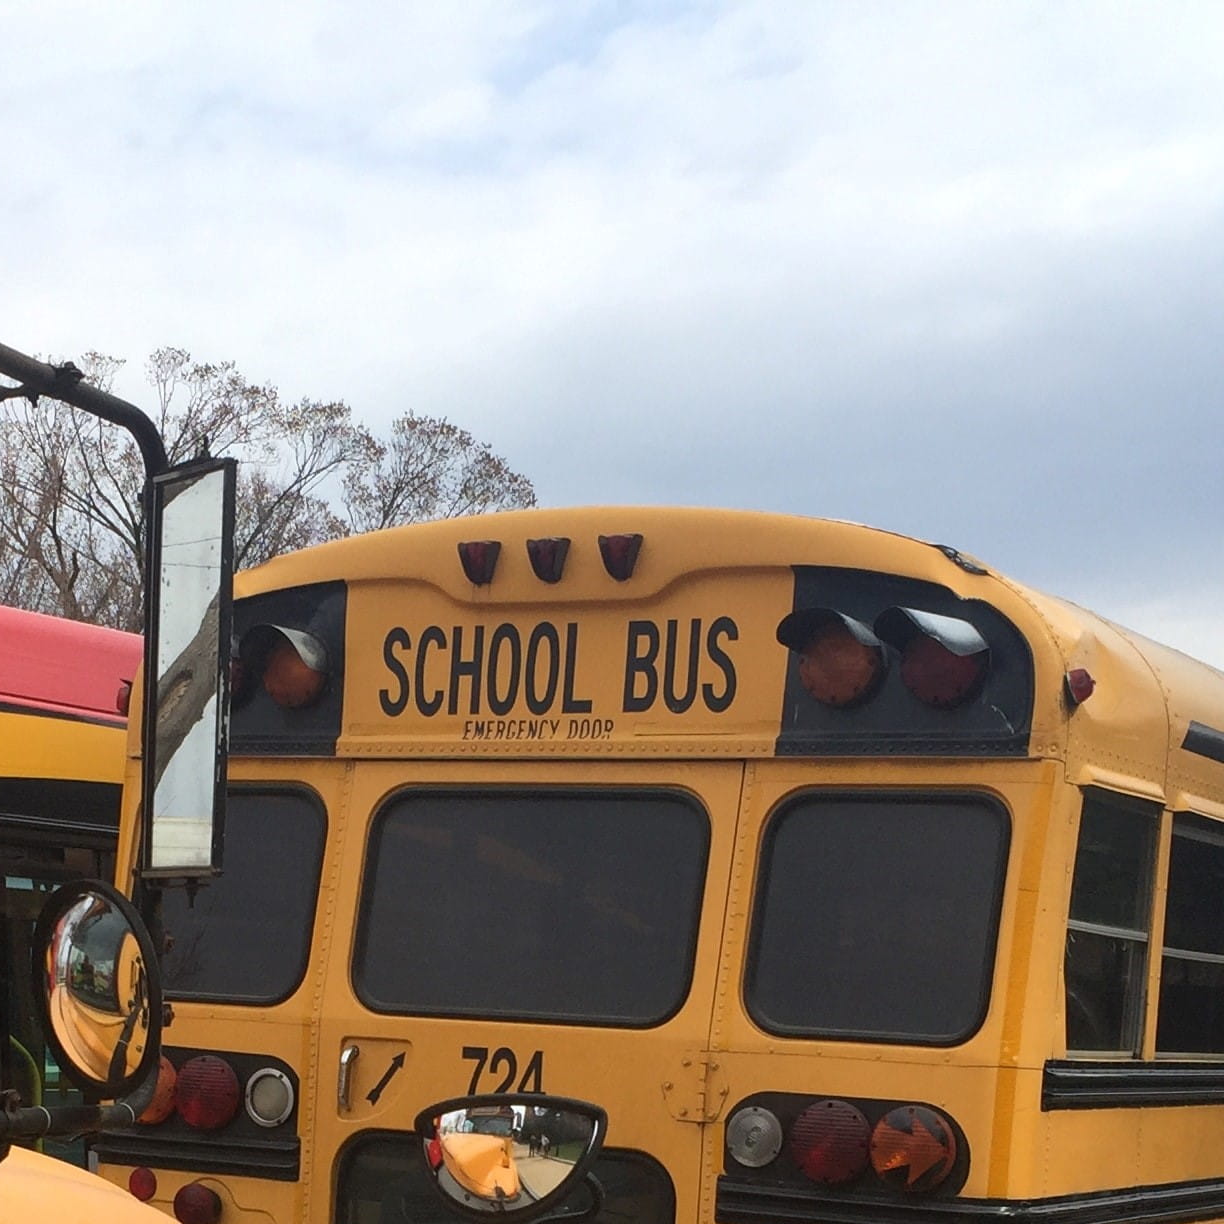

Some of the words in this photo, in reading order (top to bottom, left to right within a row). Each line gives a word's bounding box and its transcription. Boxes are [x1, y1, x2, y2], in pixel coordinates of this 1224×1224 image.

[378, 621, 592, 717] SCHOOL
[622, 616, 739, 714] BUS
[462, 719, 560, 741] EMERGENCY
[566, 719, 615, 740] DOOR
[462, 1046, 546, 1096] 724
